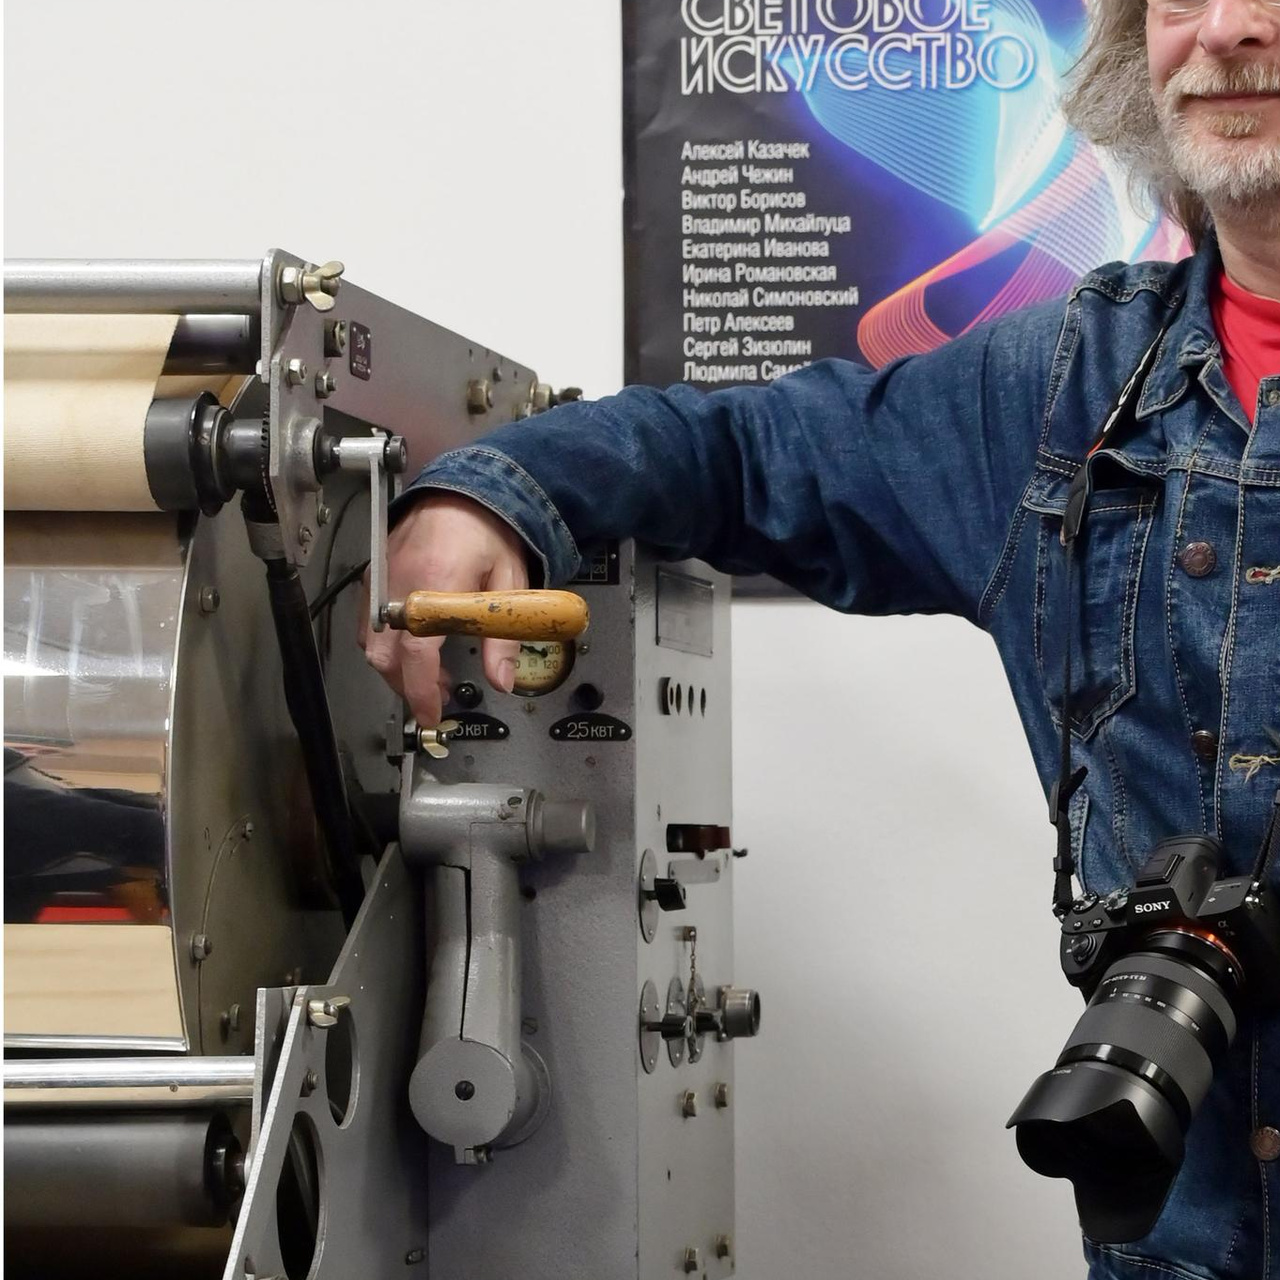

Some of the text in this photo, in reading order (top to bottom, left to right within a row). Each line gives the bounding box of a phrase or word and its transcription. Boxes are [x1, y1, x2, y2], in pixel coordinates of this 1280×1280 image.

[681, 0, 991, 36] СВЕТОВОЕ
[681, 33, 1035, 95] ИСКУССТВО
[681, 139, 810, 160] Алексей Казачек
[681, 164, 794, 188] Андрей Чежин
[682, 188, 806, 212] Виктор Борисов
[682, 213, 851, 236] Владимир Михайлуца
[682, 238, 829, 261] Екатерина Иванова
[682, 262, 837, 287] Ирина Романовская
[683, 286, 859, 308] Николай Симоновский
[683, 312, 794, 336] Петр Алексеев
[683, 336, 812, 360] Сергей Зизюлин
[683, 361, 757, 382] Людмила
[1134, 900, 1171, 914] SONY
